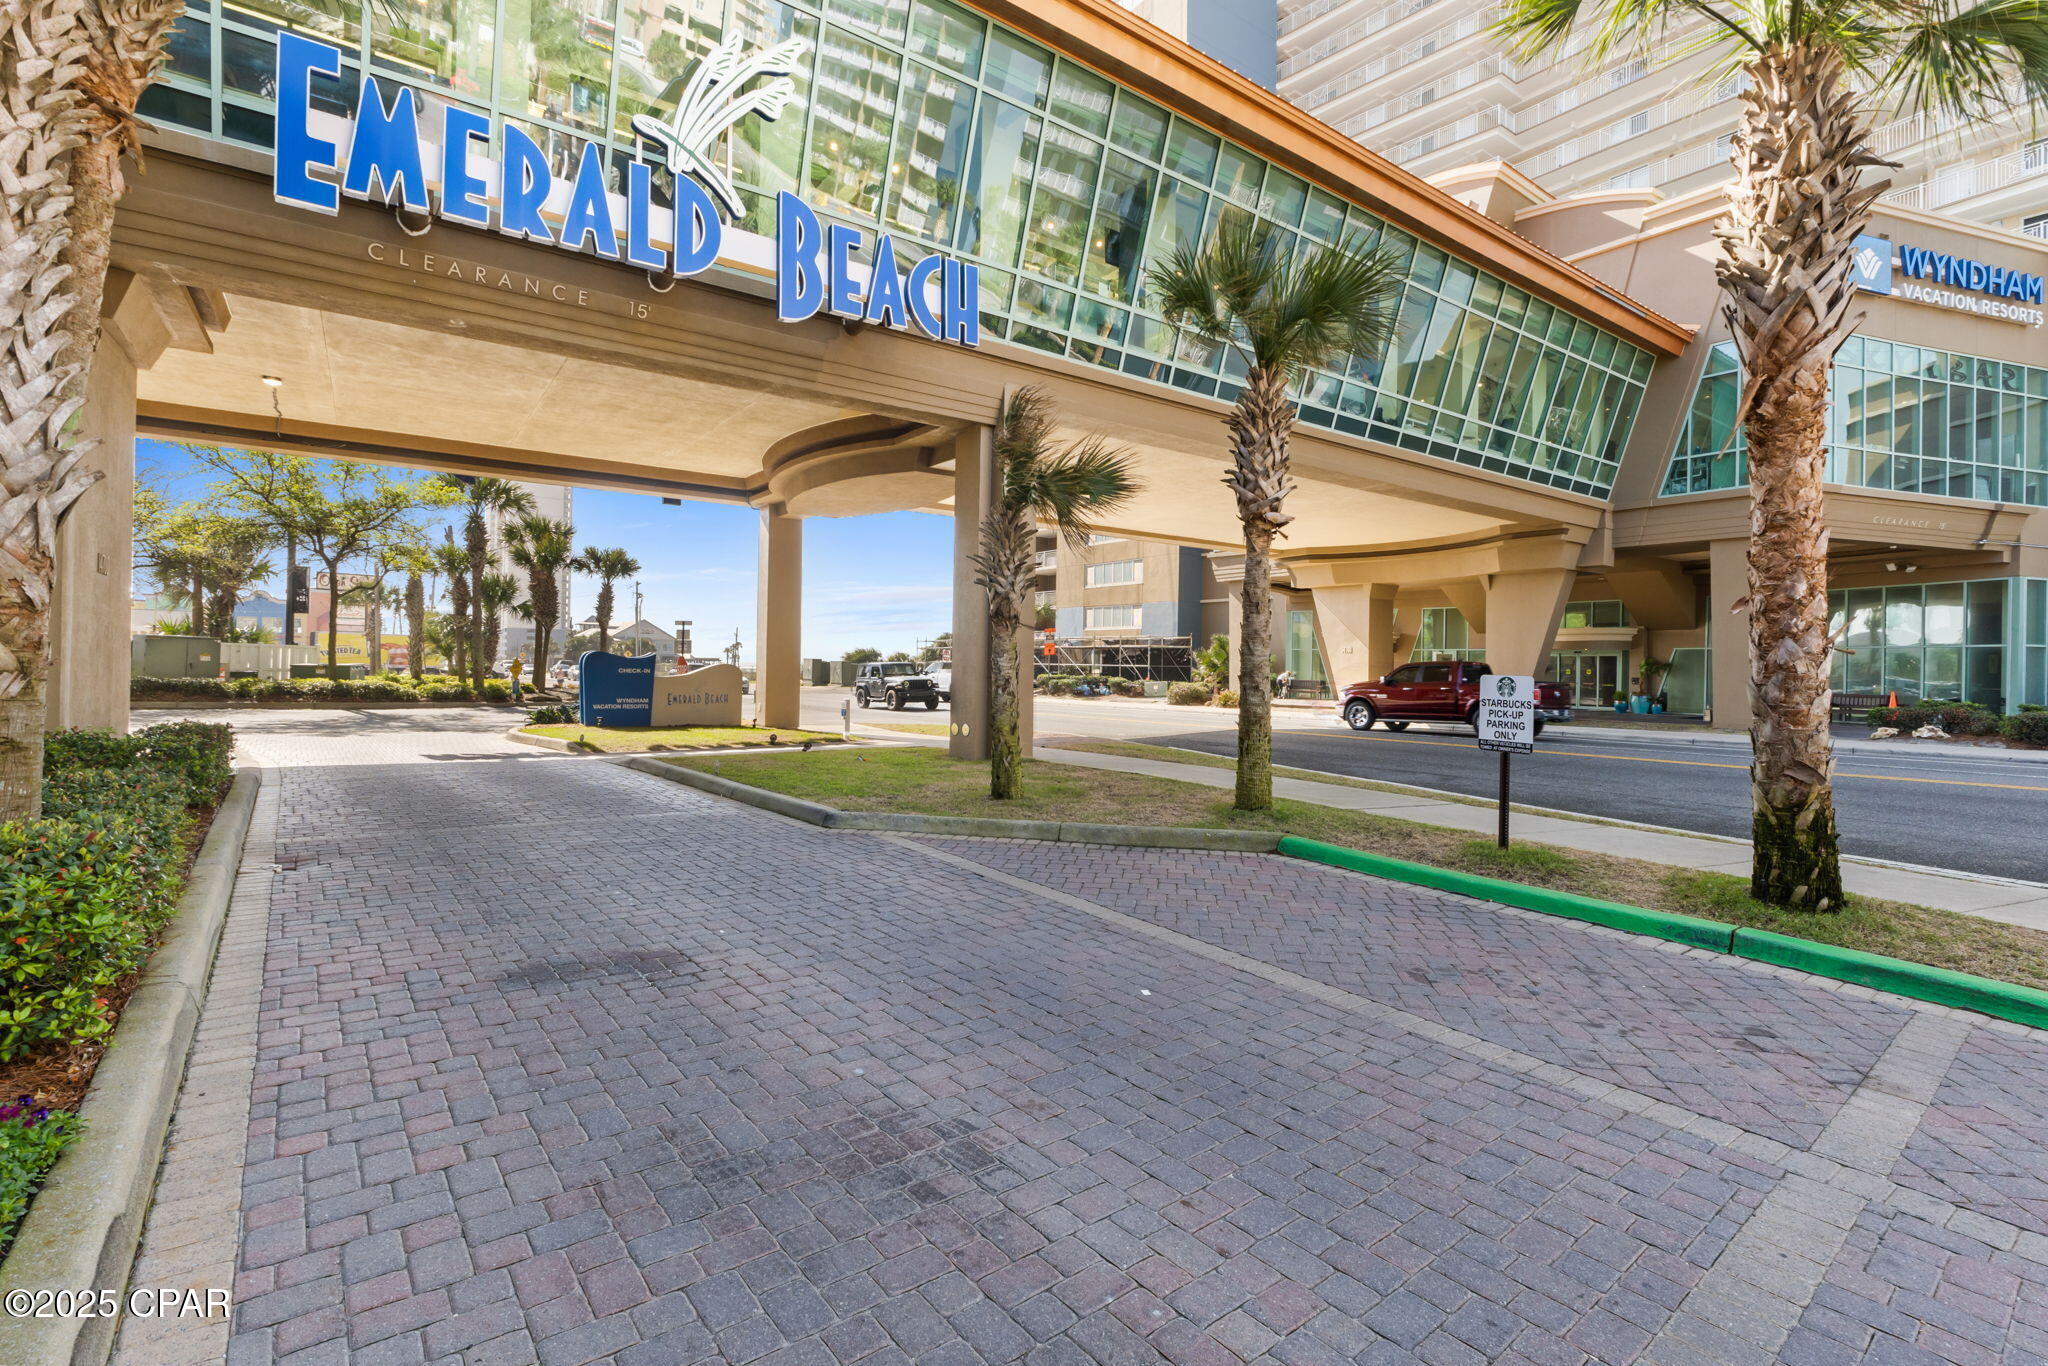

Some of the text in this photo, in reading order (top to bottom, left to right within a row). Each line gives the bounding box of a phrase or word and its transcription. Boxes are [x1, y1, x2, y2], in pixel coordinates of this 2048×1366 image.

[274, 30, 981, 347] EMERALD BEACH
[368, 243, 588, 306] CLEARANCE
[1899, 244, 2044, 304] WYNDHAM
[1903, 282, 2044, 326] VACATION RESORTS
[1872, 516, 1930, 529] CLEARANCE
[667, 692, 729, 706] EMERALD BEACH
[1481, 698, 1532, 710] STARBUCKS
[1488, 709, 1524, 720] PICK-UP
[1486, 720, 1526, 730] PARKING
[1494, 731, 1518, 740] ONLY
